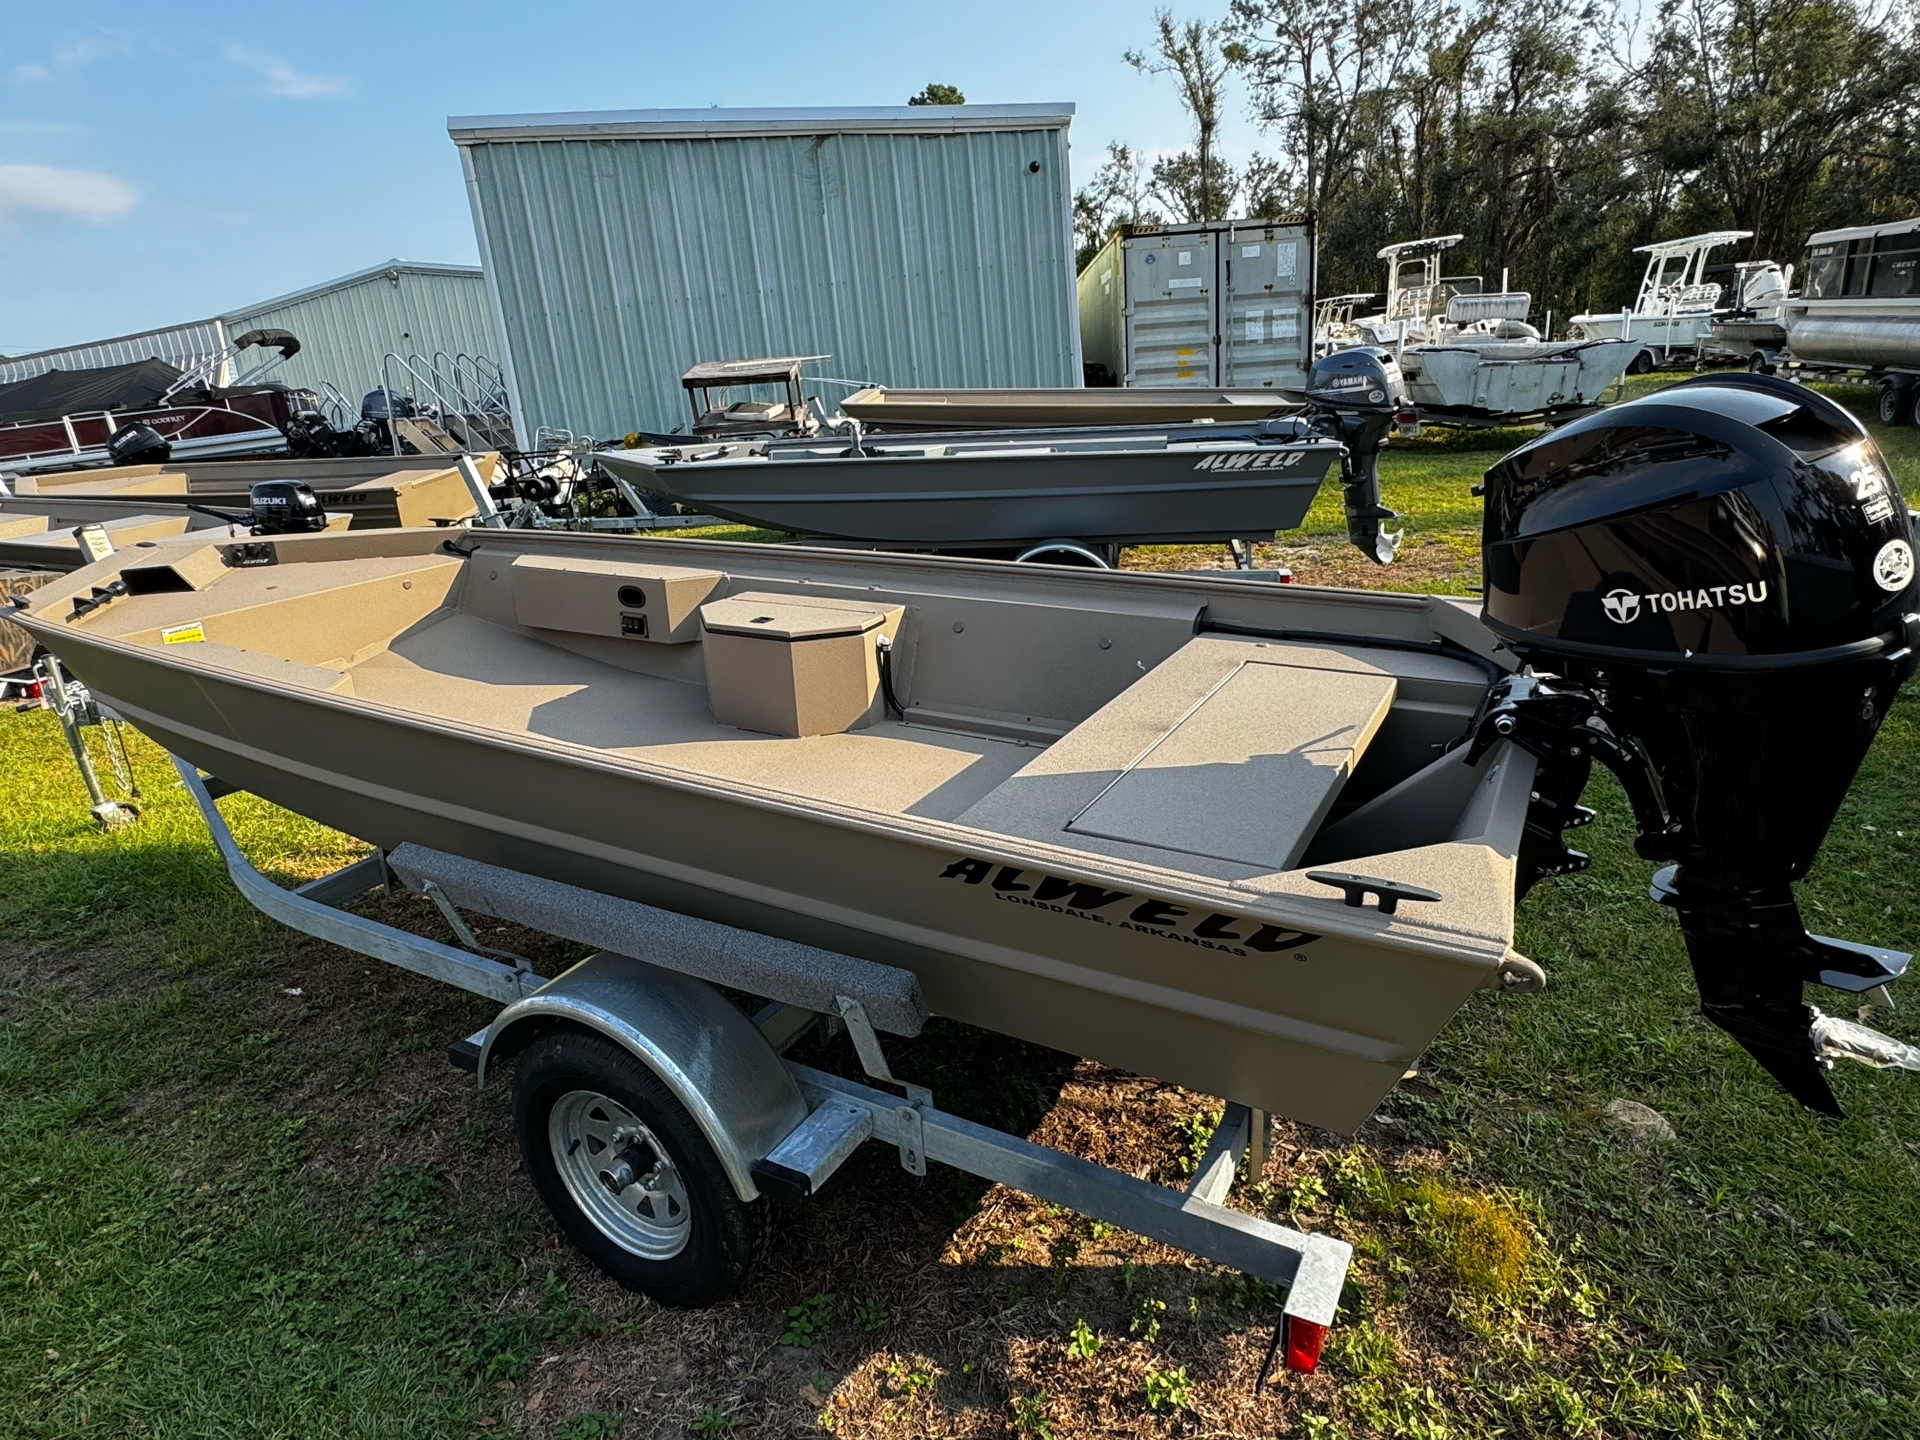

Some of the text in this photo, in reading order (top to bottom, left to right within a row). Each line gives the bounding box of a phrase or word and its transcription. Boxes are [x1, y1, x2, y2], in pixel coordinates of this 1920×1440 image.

[1892, 260, 1917, 268] CREST
[1340, 375, 1368, 386] YAMAHA
[151, 415, 185, 425] GODFREY
[113, 430, 138, 448] SUZUKI
[1193, 451, 1306, 470] ALWELD
[1850, 465, 1882, 500] 25
[253, 497, 286, 505] SUZUKI
[317, 493, 367, 503] LWELD
[1644, 580, 1768, 613] TOHATSU
[938, 857, 1324, 954] ALWELD
[995, 892, 1248, 957] LONSDALE, ARKANSAS
